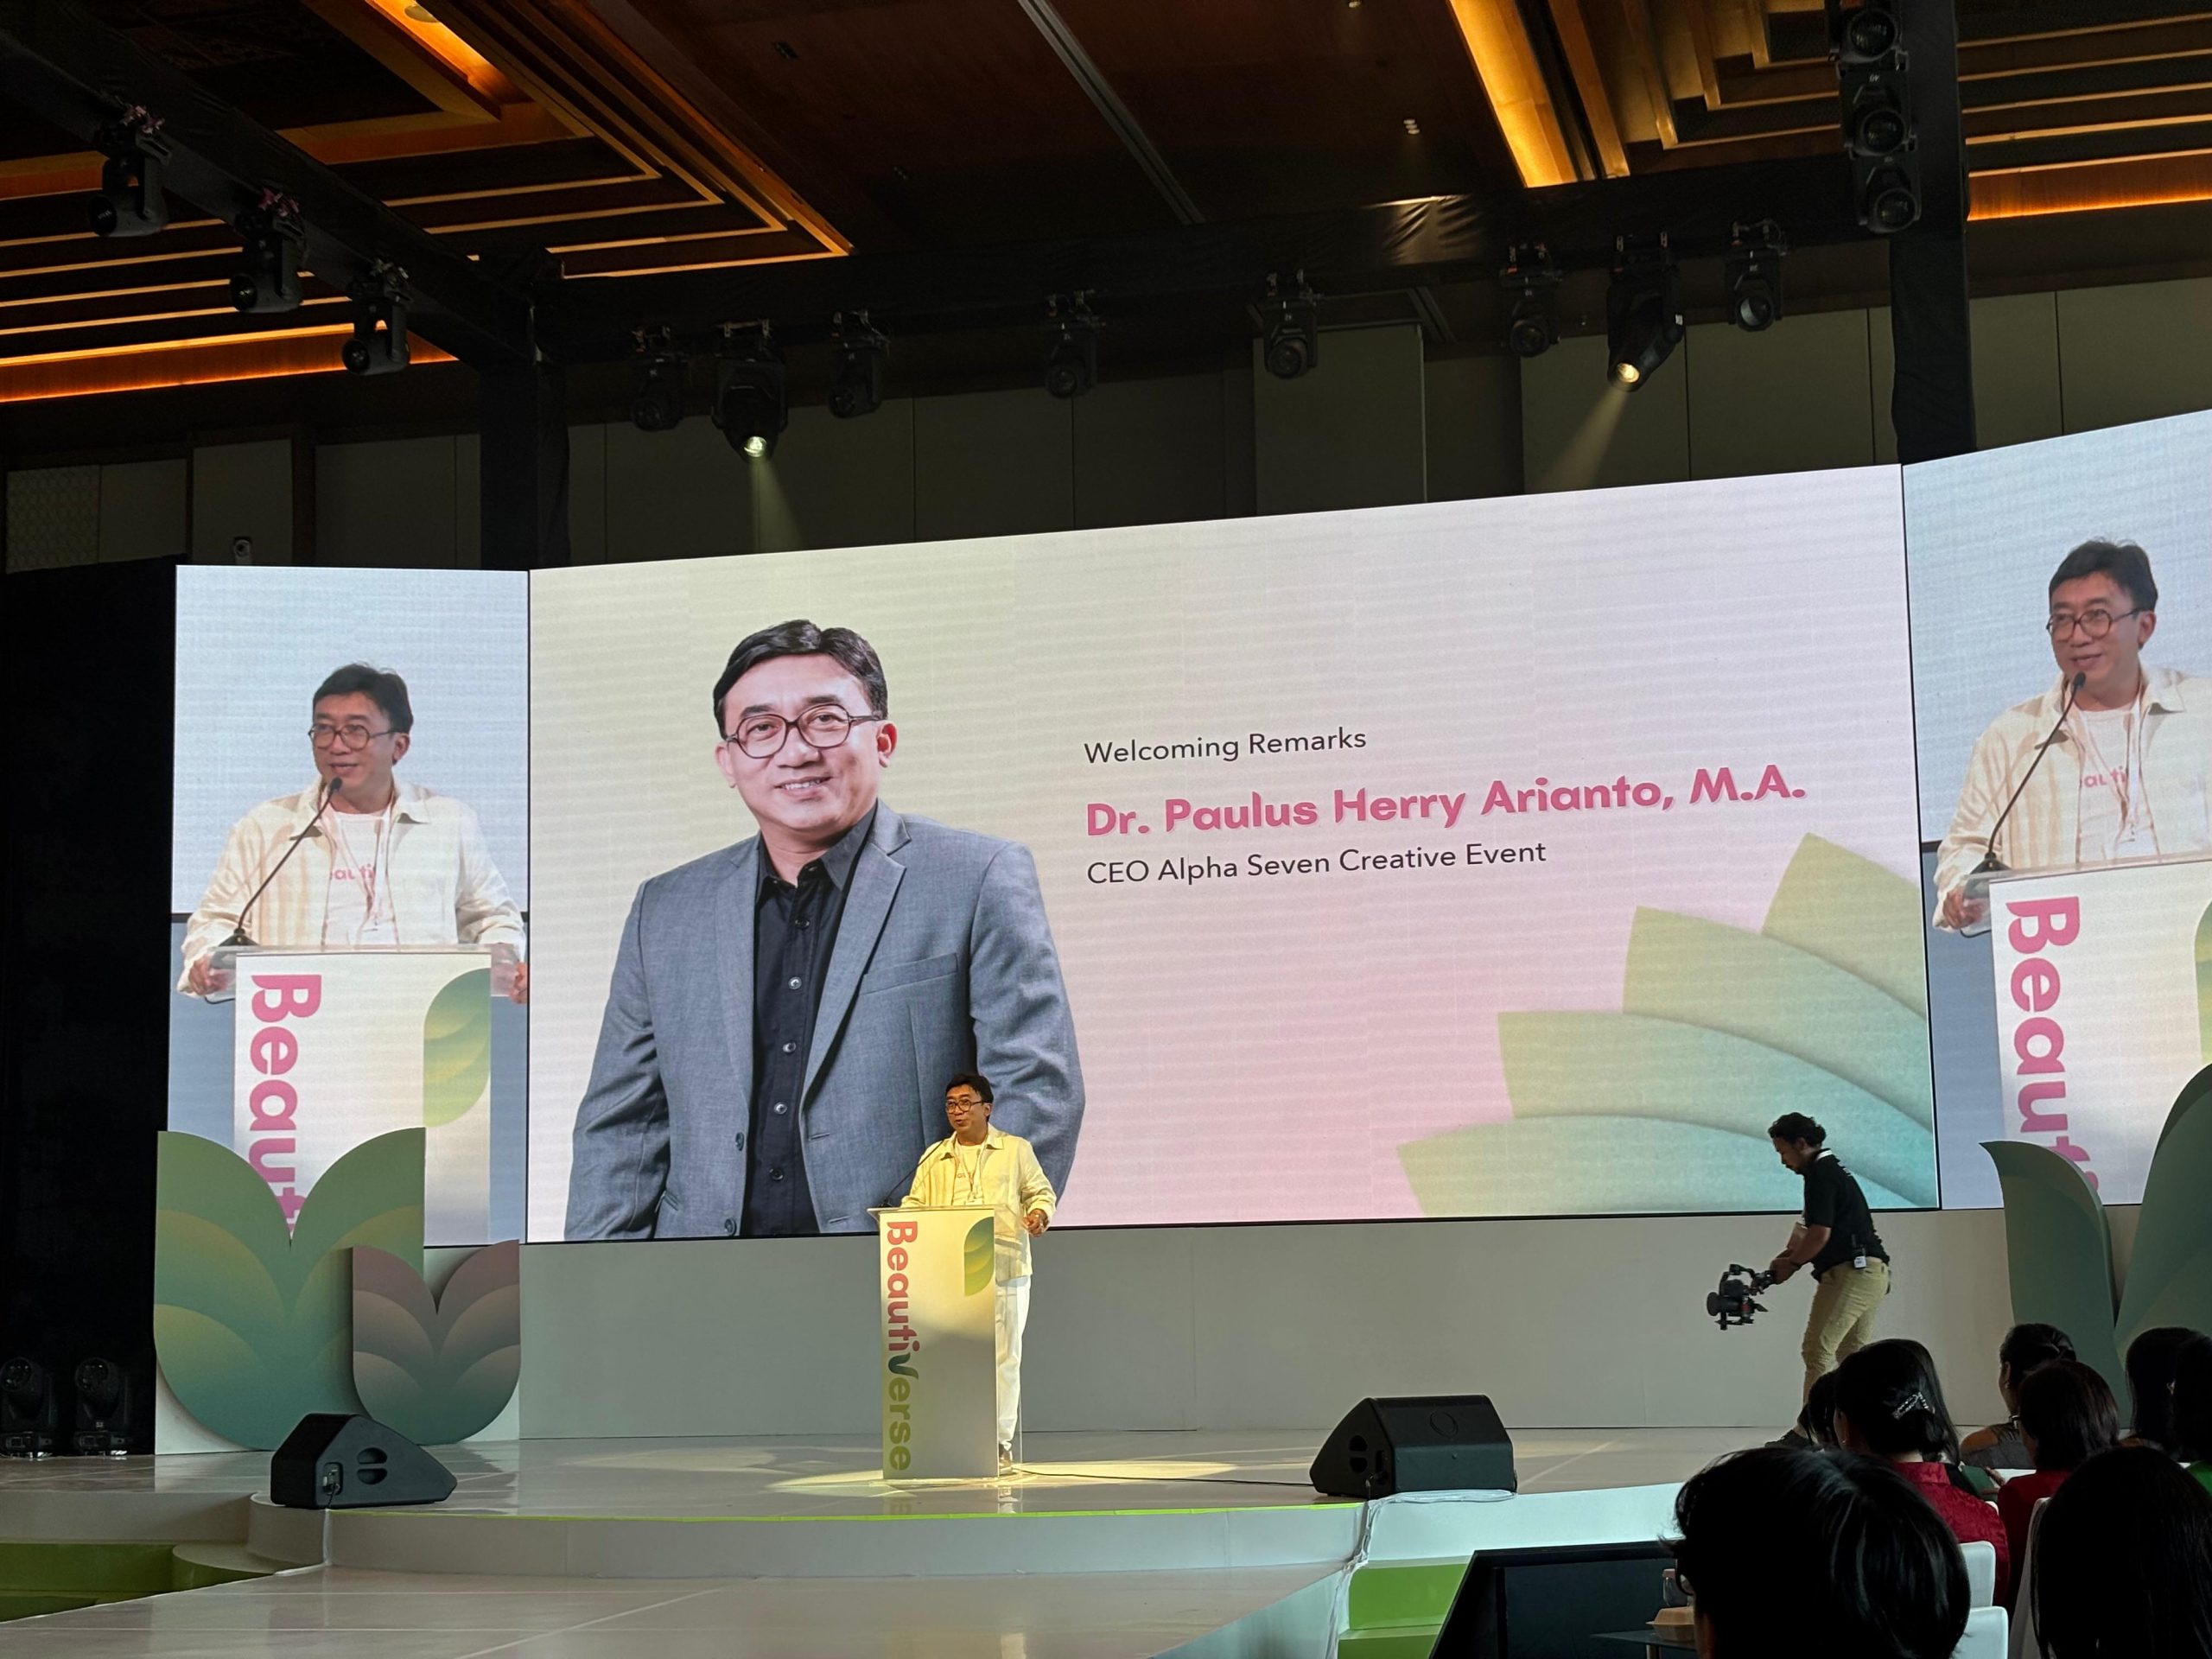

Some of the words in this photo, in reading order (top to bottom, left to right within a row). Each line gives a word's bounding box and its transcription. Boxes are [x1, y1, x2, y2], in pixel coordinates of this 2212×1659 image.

[1084, 737, 1239, 763] Welcoming
[1249, 727, 1367, 754] Remarks
[1087, 803, 1150, 836] Dr.
[1166, 791, 1319, 832] Paulus
[1334, 788, 1466, 829] Herry
[1480, 775, 1674, 816] Arianto,
[1689, 764, 1806, 804] M.A.
[1087, 860, 1149, 883] CEO
[1158, 857, 1238, 885] Alpha
[1248, 854, 1330, 876] Seven
[1339, 847, 1457, 872] Creative
[1466, 842, 1547, 865] Event
